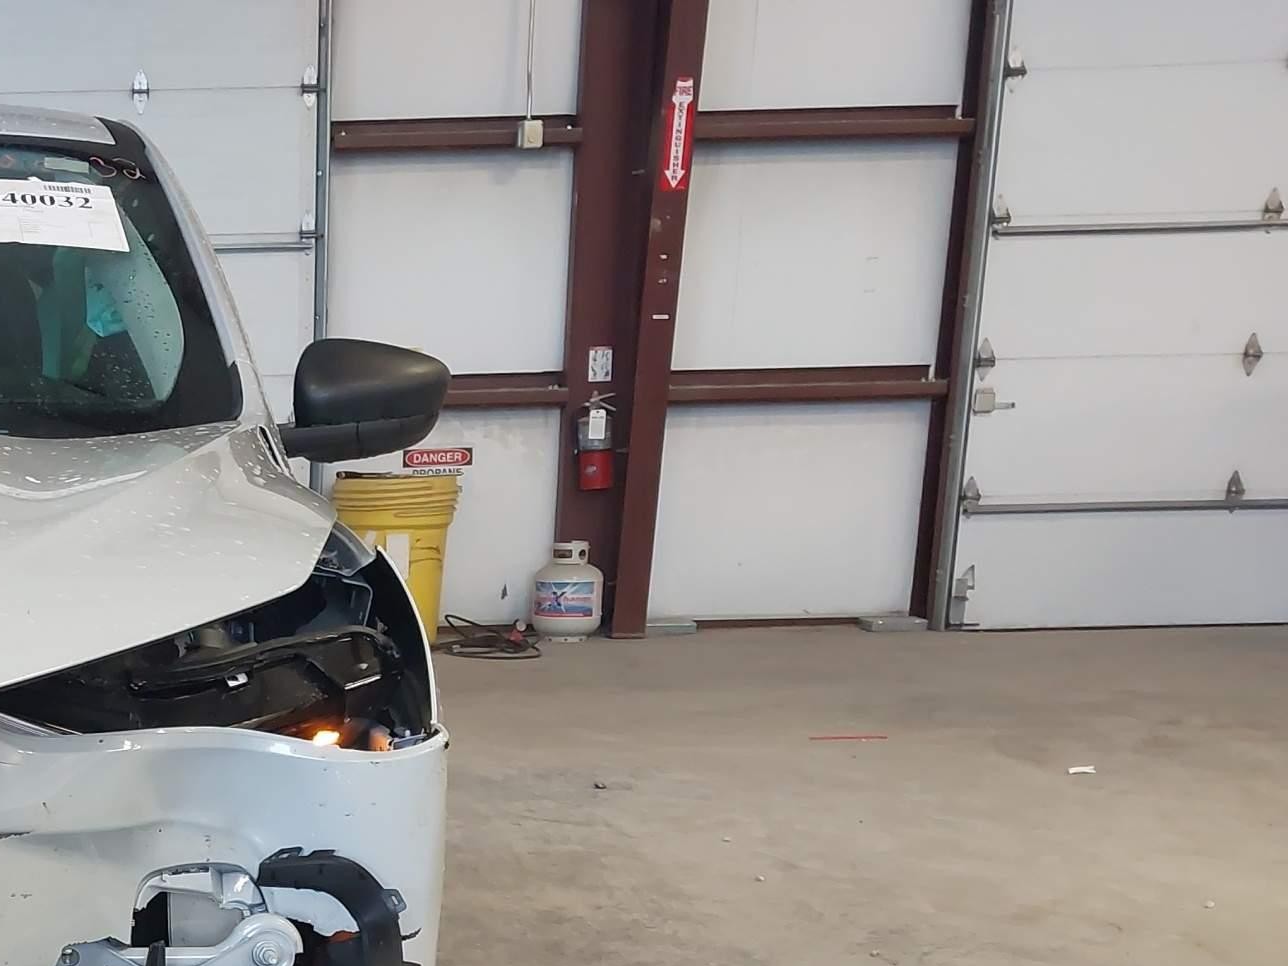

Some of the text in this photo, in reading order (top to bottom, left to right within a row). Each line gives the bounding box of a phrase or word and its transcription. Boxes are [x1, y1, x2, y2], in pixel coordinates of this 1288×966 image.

[675, 86, 692, 96] FIRE
[671, 101, 686, 181] EXTINGUISHER
[413, 452, 463, 463] DANGER
